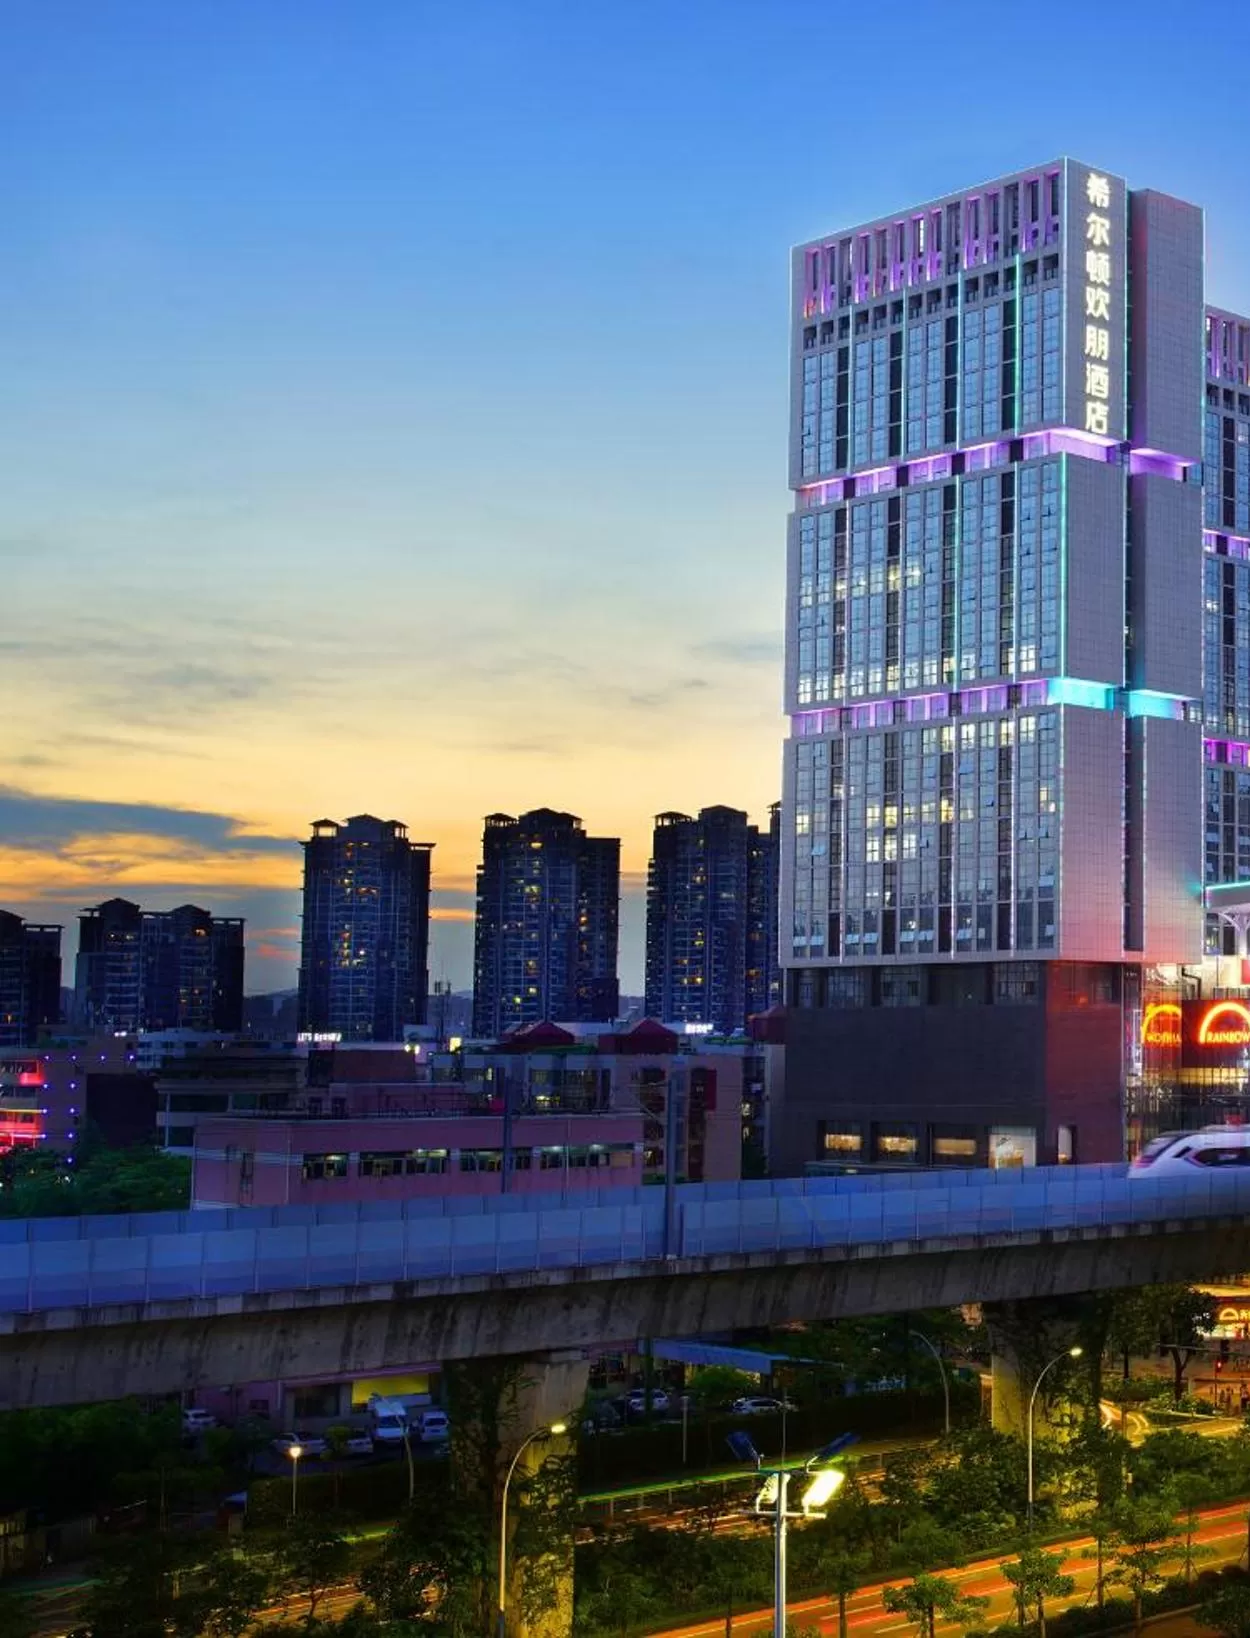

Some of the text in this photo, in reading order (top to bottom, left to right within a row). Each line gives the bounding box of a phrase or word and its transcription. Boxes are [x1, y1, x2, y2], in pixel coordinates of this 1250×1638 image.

[1085, 173, 1110, 434] 希尔顿欢朋酒店
[1206, 1031, 1250, 1044] RAINBOW
